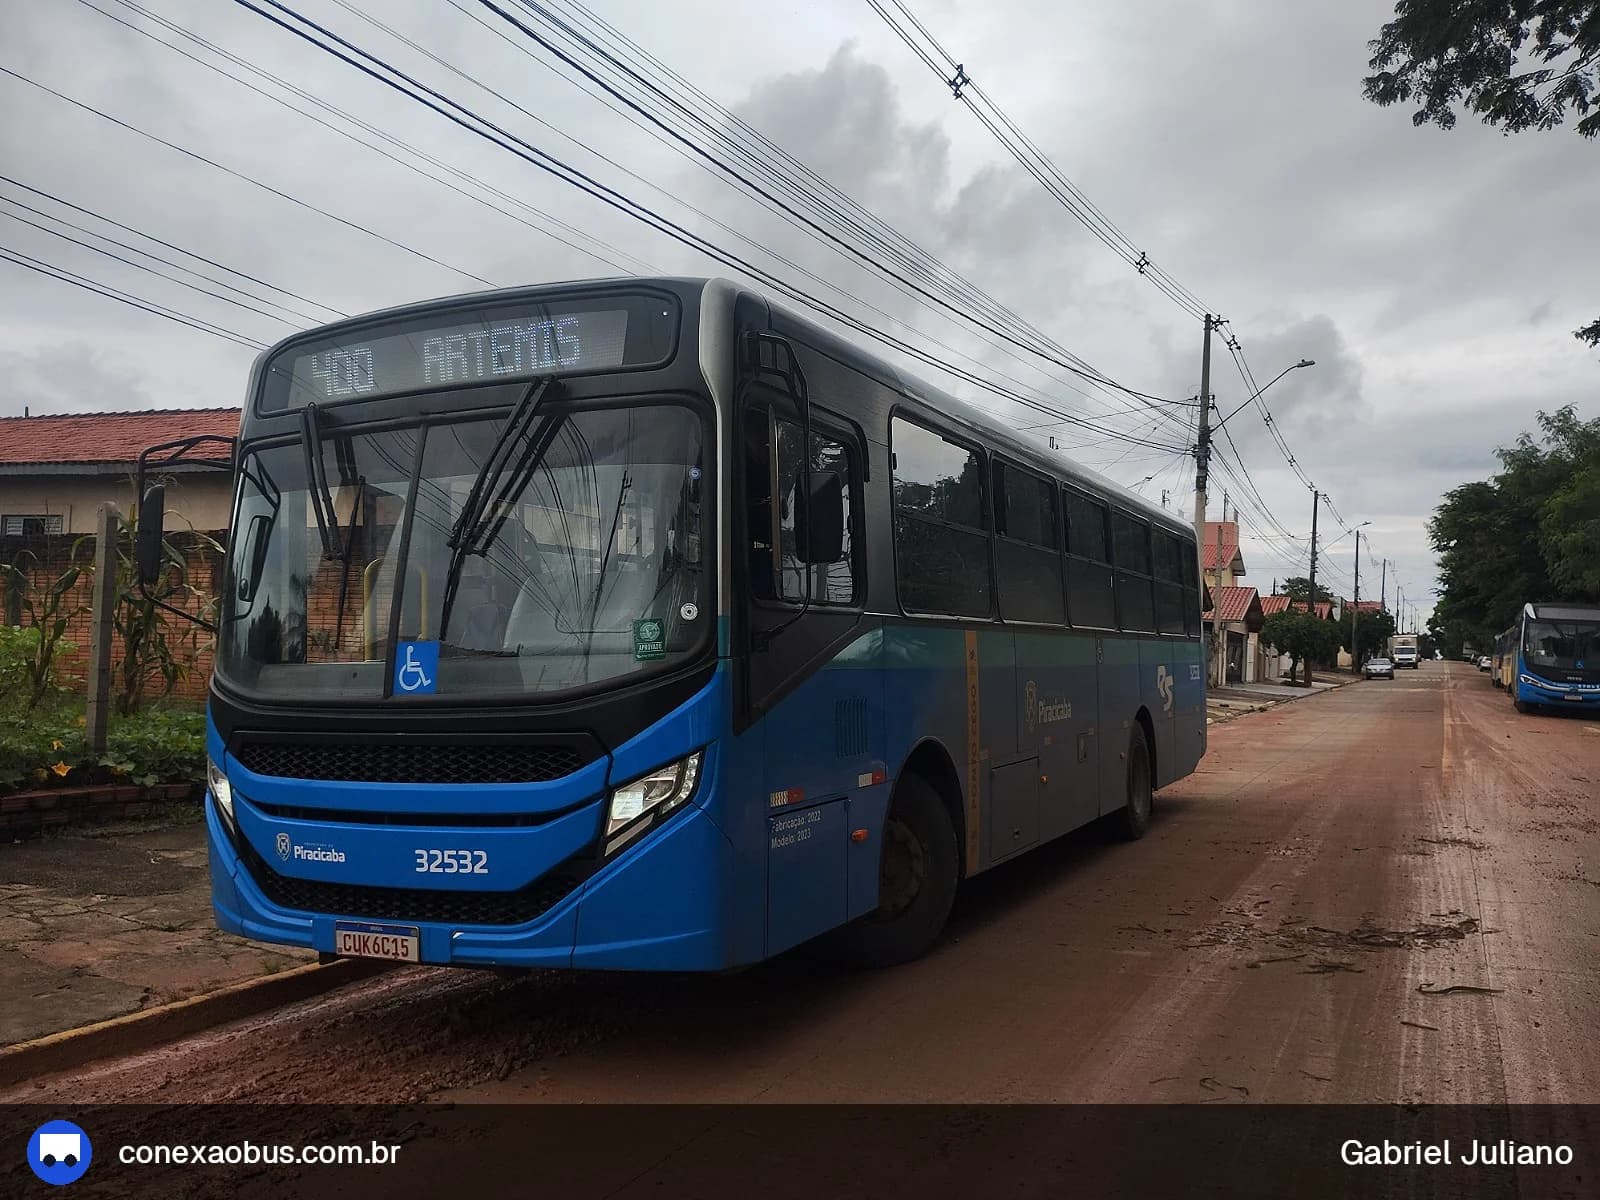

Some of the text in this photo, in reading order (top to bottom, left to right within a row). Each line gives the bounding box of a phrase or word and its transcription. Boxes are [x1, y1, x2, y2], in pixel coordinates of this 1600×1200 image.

[312, 315, 580, 396] 400 ARTEMIS
[807, 810, 821, 823] 2022
[294, 846, 346, 863] Piracicaba
[415, 849, 489, 874] 32532
[343, 933, 409, 957] CUK6C15
